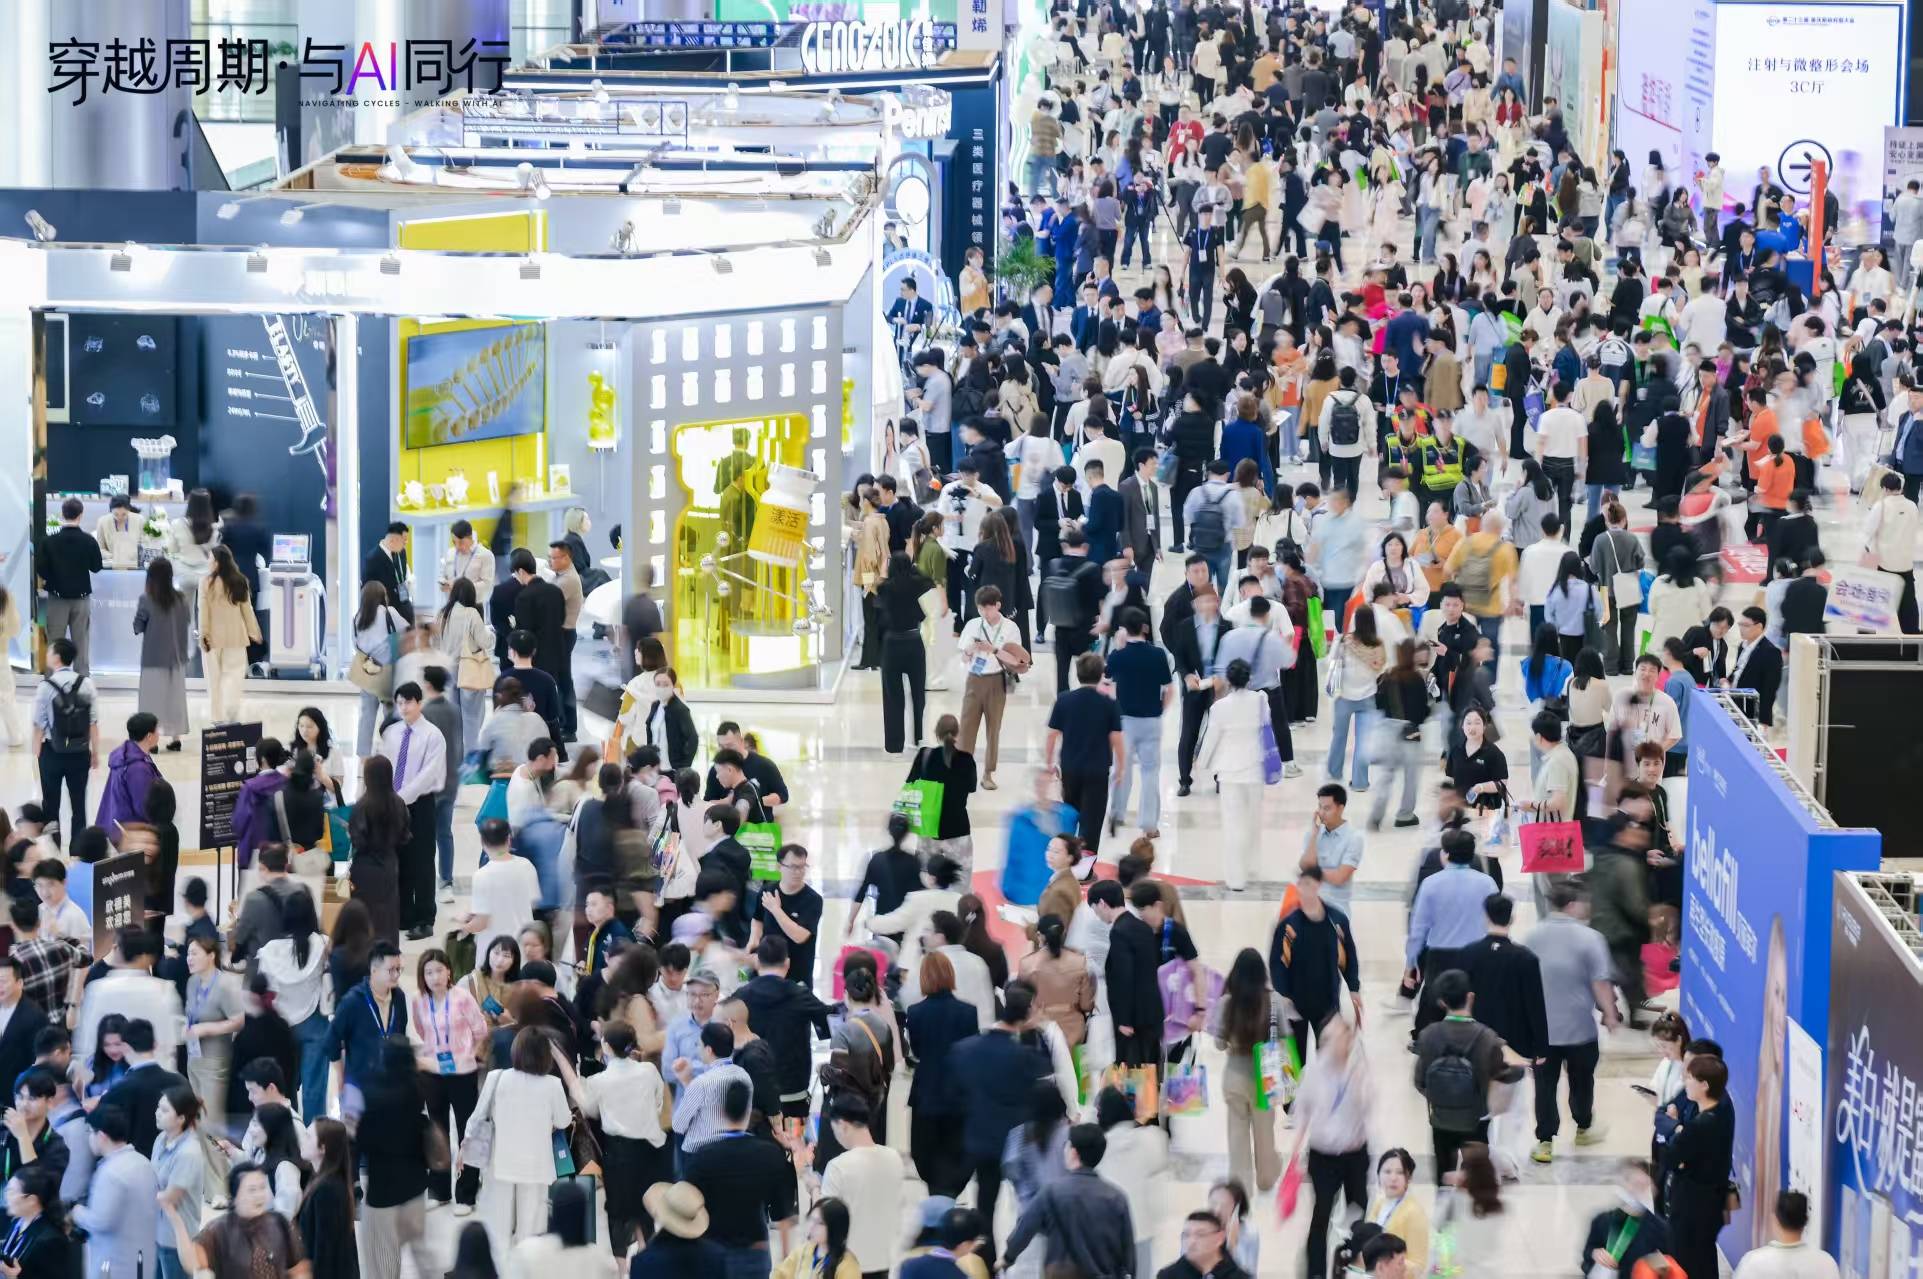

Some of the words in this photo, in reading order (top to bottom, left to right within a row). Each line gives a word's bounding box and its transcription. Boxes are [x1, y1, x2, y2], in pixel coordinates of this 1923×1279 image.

[1747, 57, 1870, 74] 注射与微整形会场
[1789, 80, 1825, 95] 3C厅
